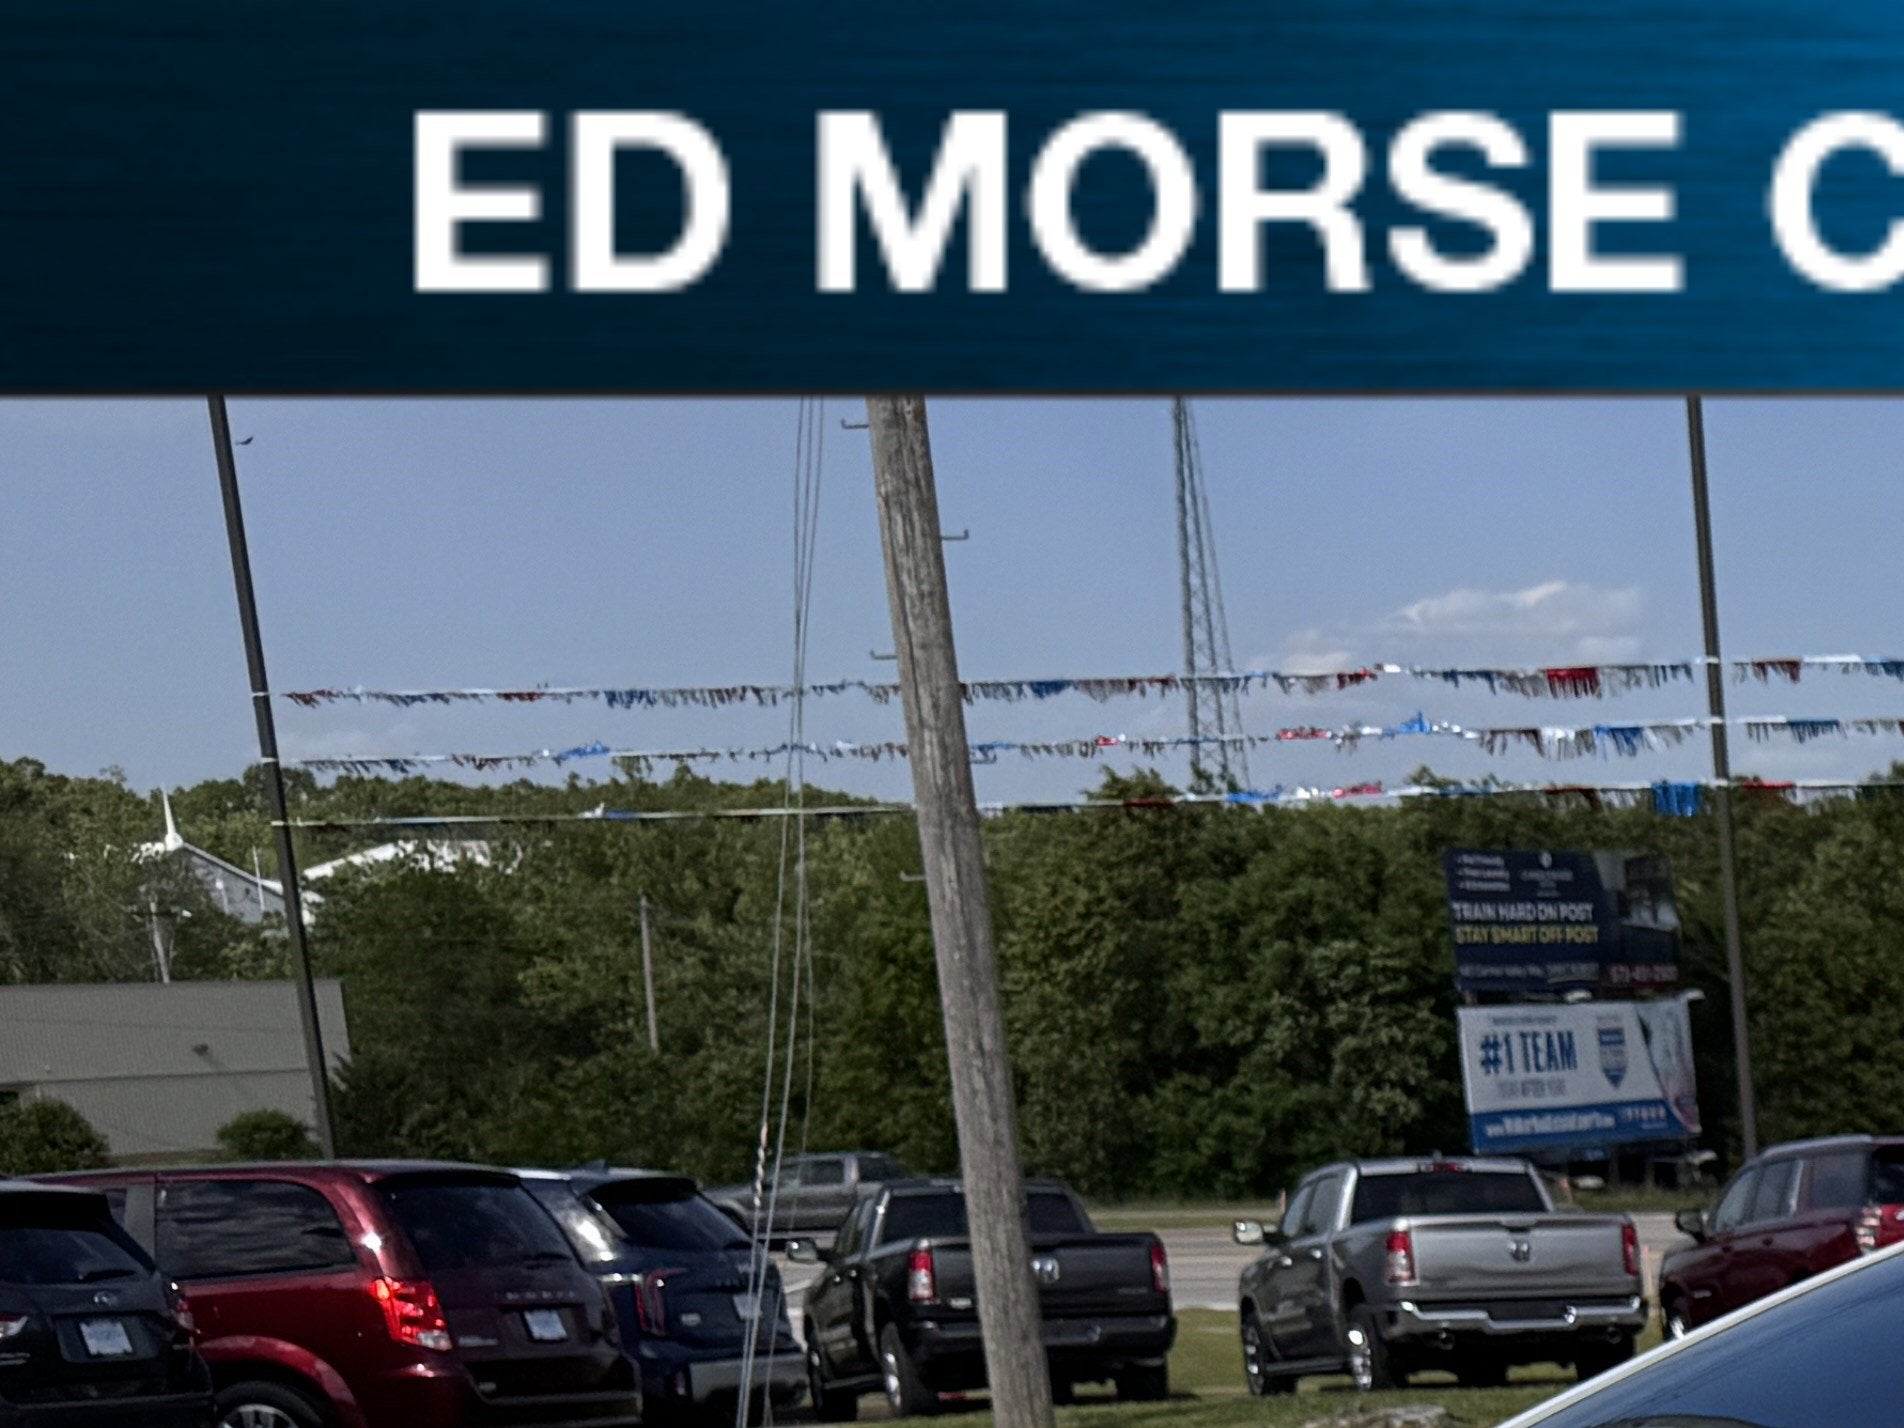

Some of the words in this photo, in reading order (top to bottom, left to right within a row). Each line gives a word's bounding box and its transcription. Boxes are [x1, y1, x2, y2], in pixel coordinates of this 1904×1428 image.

[1452, 901, 1496, 921] TRAIN
[1498, 901, 1536, 921] HARD
[1537, 901, 1558, 921] ON
[1559, 901, 1594, 922] POST
[1455, 924, 1489, 944] STAY
[1490, 924, 1536, 944] SMART
[1565, 924, 1599, 944] POST
[1480, 1031, 1515, 1075] #1
[1519, 1029, 1578, 1073] TEAM
